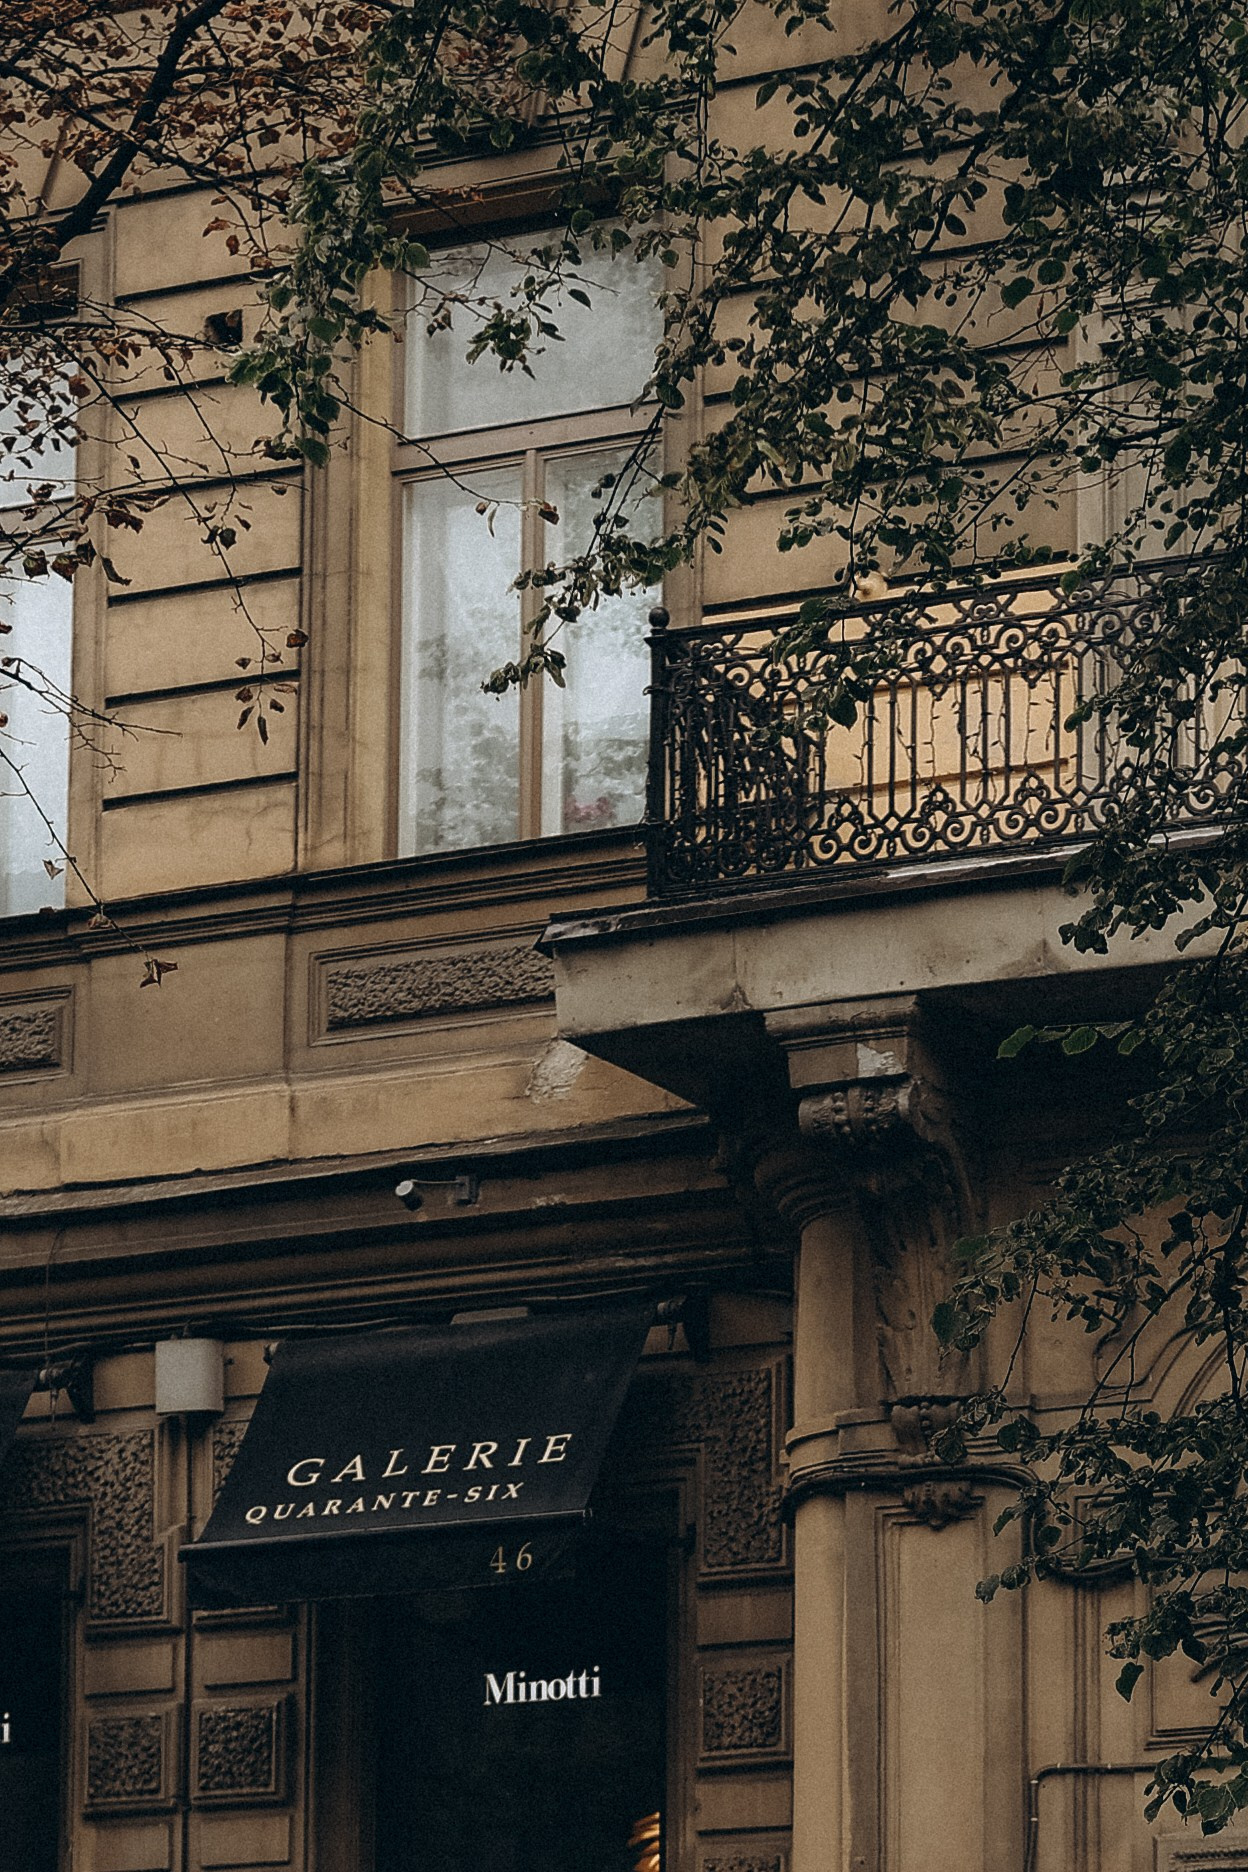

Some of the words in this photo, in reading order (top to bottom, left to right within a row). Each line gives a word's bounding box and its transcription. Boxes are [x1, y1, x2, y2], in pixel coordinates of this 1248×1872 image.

[286, 1433, 573, 1488] GALERIE
[244, 1481, 526, 1526] QUARANTE-SIX
[489, 1542, 534, 1575] 46
[483, 1665, 602, 1706] Minotti
